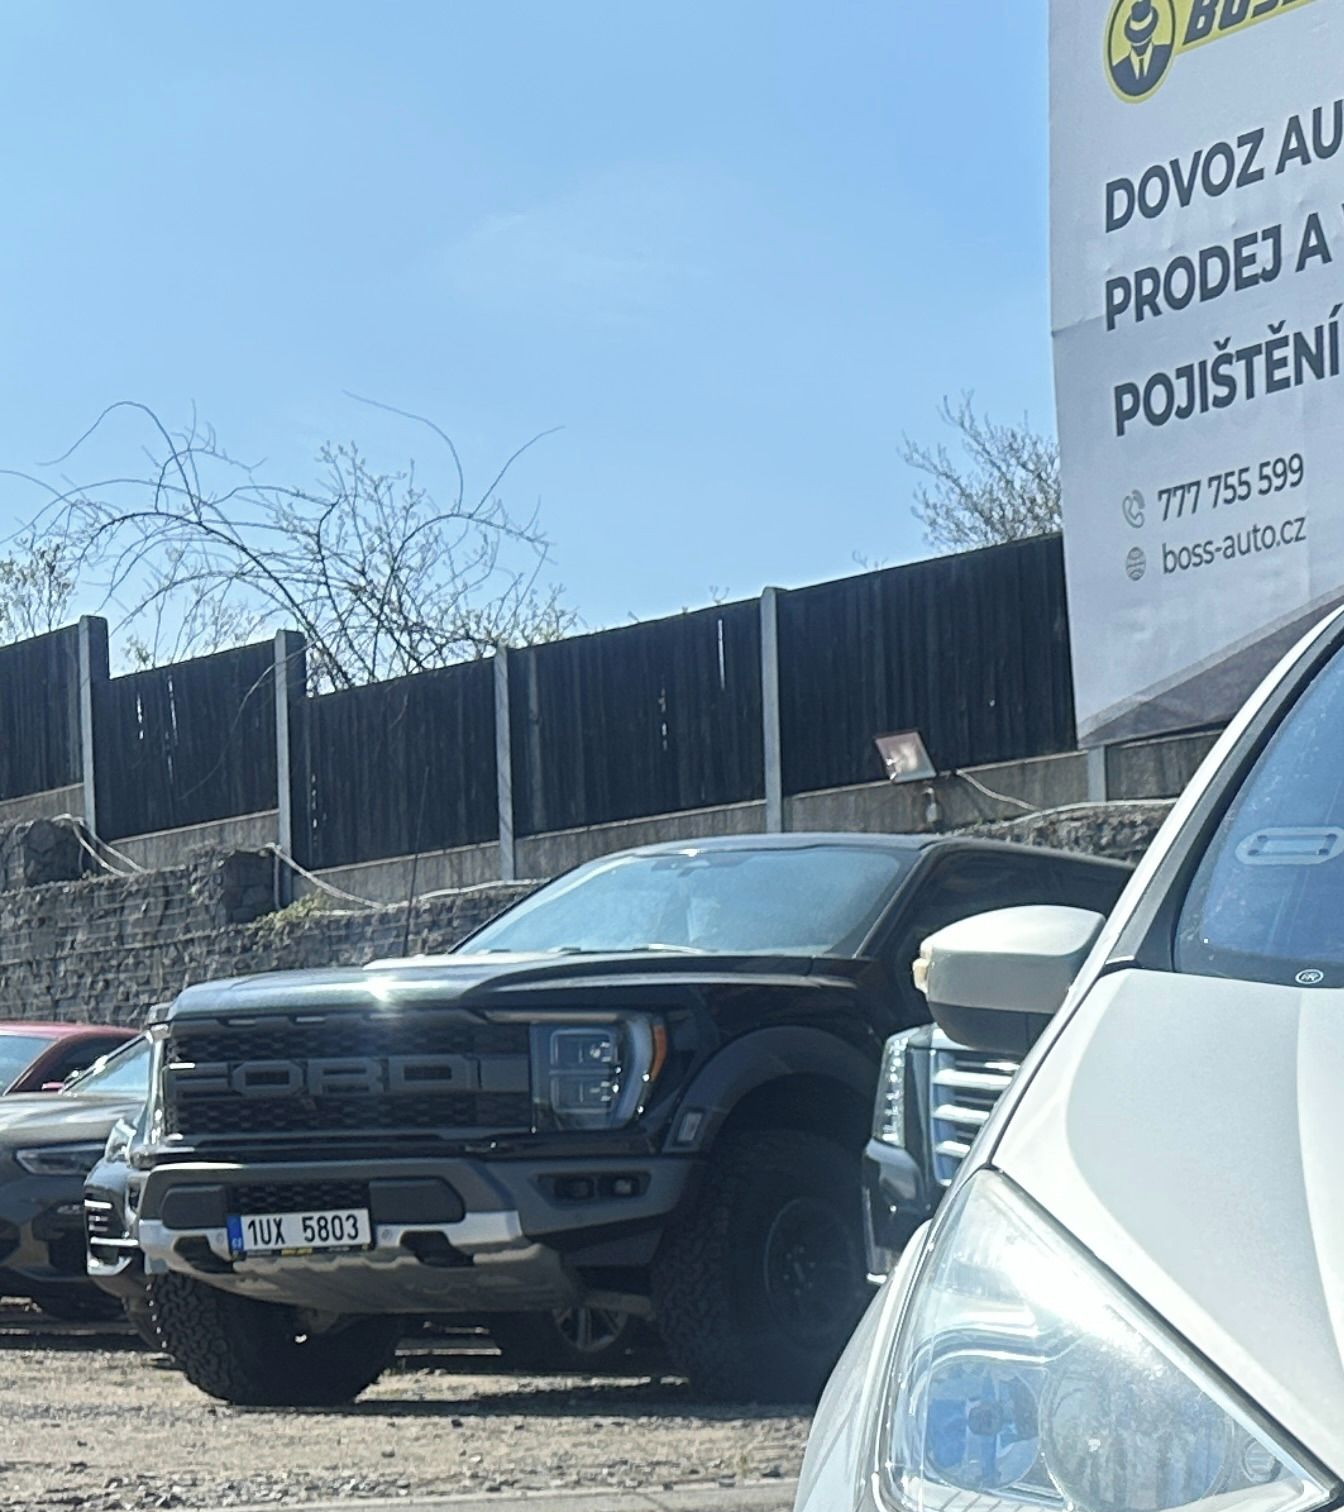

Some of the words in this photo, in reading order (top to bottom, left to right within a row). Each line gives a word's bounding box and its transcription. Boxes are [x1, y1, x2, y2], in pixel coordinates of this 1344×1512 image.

[1105, 127, 1265, 234] DOVOZ
[1105, 223, 1282, 332] PRODEJ
[1295, 212, 1333, 273] A
[1113, 302, 1344, 437] POJIŠTĚNÍ
[1157, 479, 1202, 522] 777
[1207, 466, 1252, 509] 755
[1257, 452, 1305, 496] 599
[1161, 516, 1307, 575] boss-auto.cz
[165, 1055, 480, 1100] FORD
[247, 1217, 286, 1246] 1UX
[301, 1213, 359, 1243] 5803
